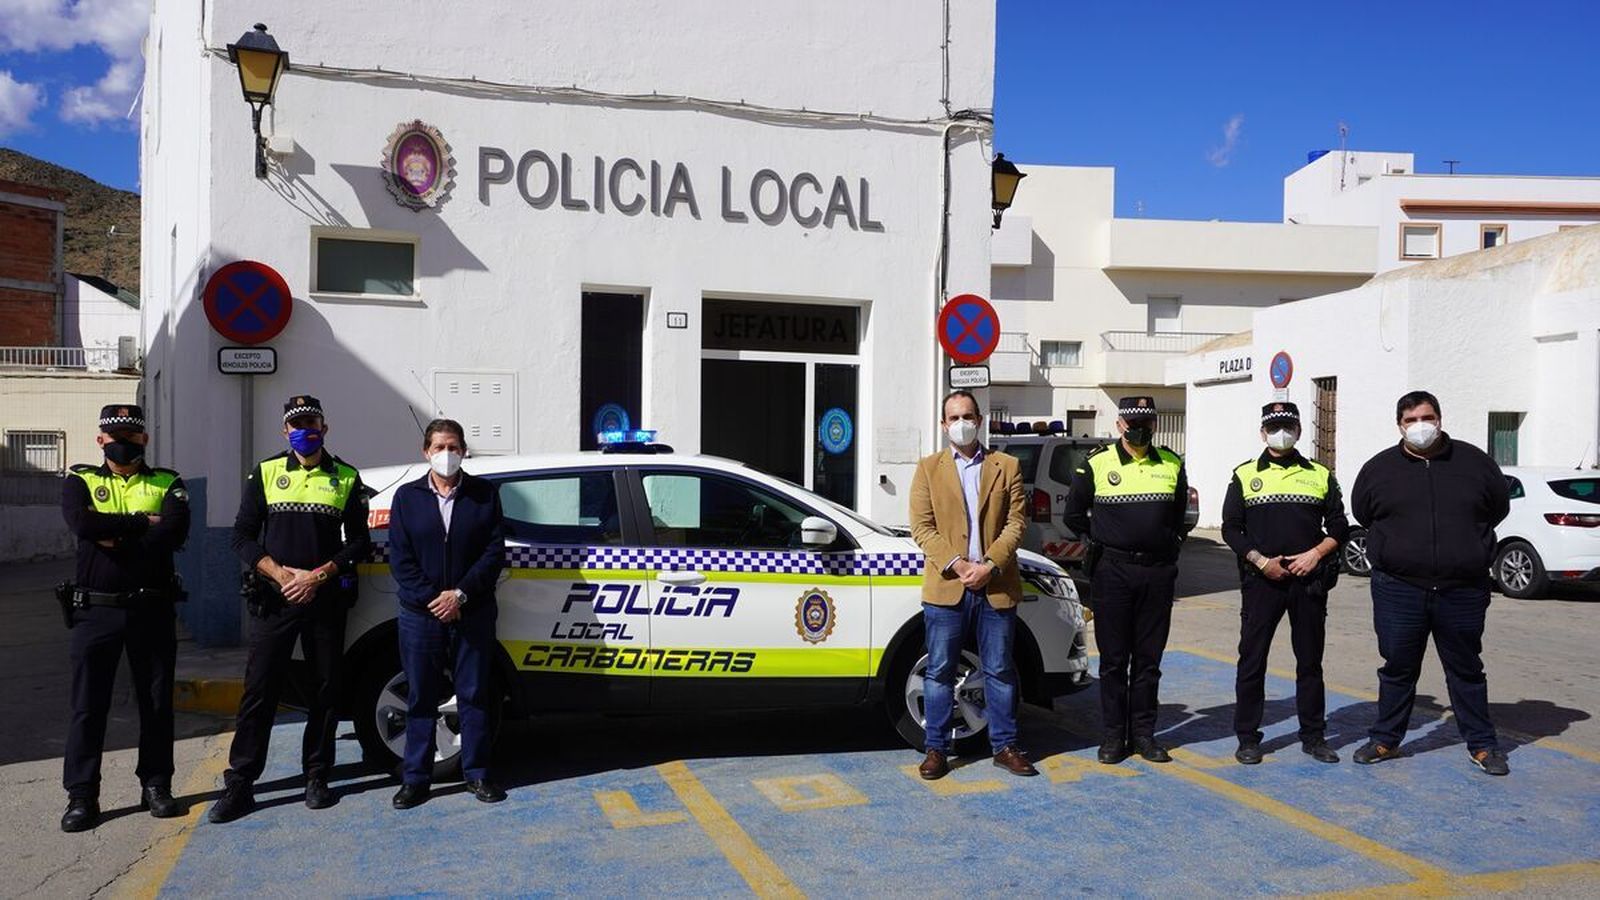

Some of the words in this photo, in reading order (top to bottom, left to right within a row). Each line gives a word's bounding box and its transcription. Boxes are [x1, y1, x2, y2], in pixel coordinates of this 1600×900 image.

[478, 146, 702, 221] POLICIA
[721, 165, 885, 233] LOCAL
[714, 312, 848, 343] JEFATURA
[234, 352, 261, 360] EXCEPTO
[250, 361, 273, 369] POLICIA
[1219, 357, 1244, 374] PLAZA
[550, 622, 634, 640] LOCAL
[522, 645, 756, 673] CARBONERAS
